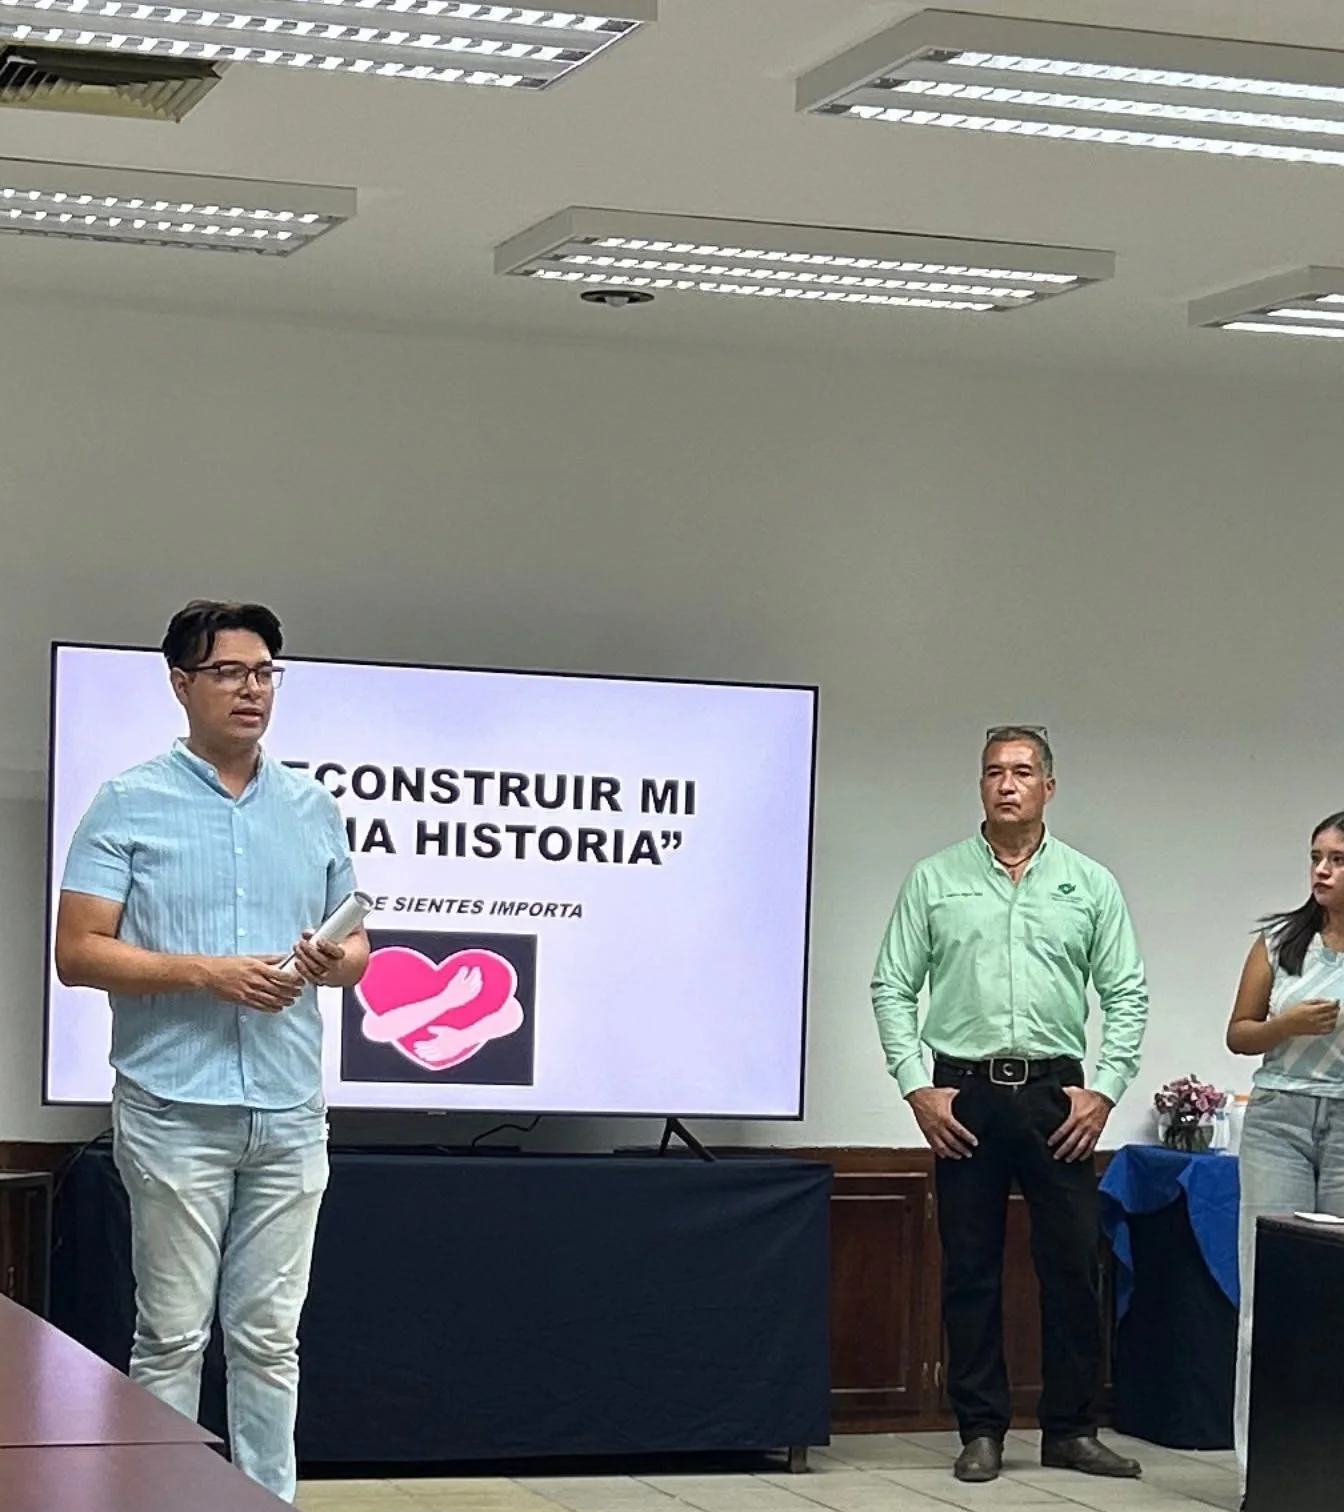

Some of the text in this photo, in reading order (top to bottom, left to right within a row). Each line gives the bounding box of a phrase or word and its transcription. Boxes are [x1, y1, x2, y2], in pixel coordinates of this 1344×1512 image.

[281, 760, 697, 815] CONSTRUIR MI
[392, 896, 485, 915] SIENTES
[489, 900, 584, 919] IMPORTA
